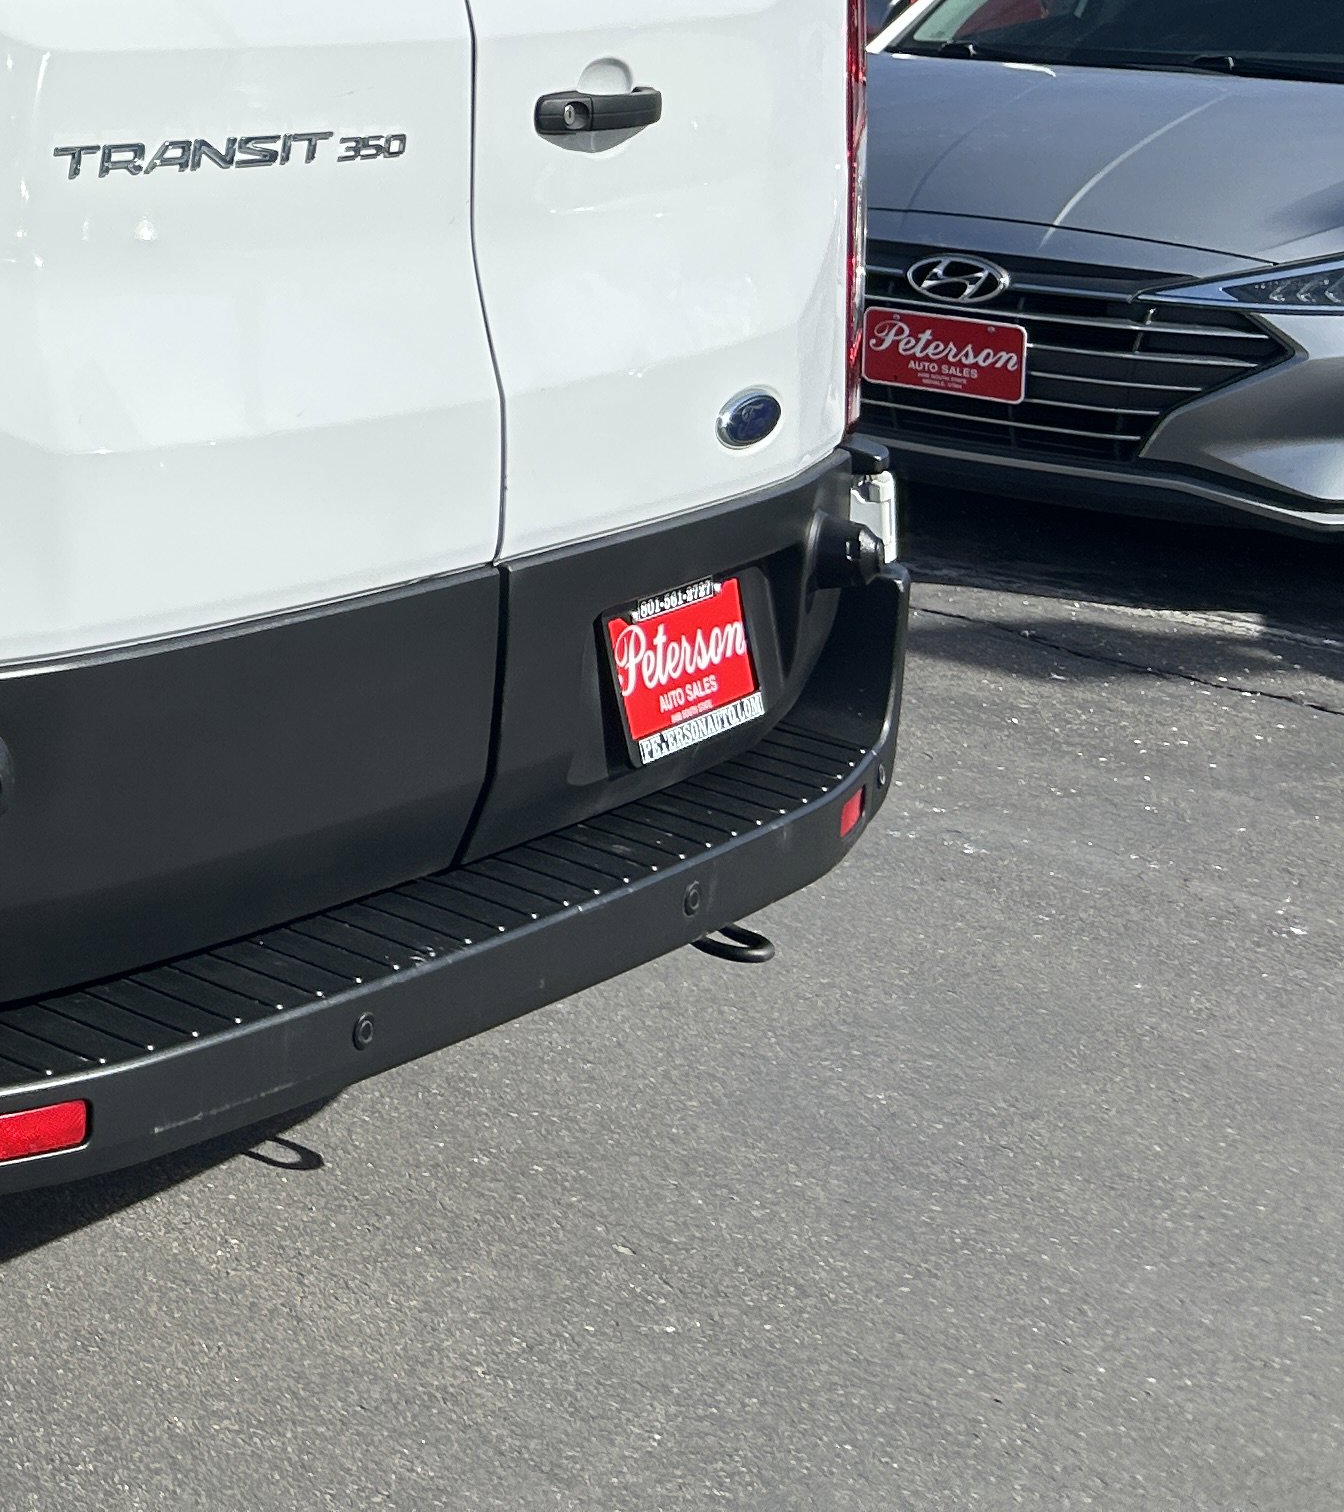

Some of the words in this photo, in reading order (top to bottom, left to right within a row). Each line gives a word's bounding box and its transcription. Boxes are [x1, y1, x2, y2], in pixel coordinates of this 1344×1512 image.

[53, 131, 334, 180] TRANSIT
[336, 132, 407, 163] 350
[869, 319, 1018, 371] Peterson
[907, 360, 939, 374] AUTO
[941, 363, 979, 379] SALES
[614, 621, 746, 696] Peterson
[659, 687, 685, 713] AUTO
[685, 674, 718, 702] SALES
